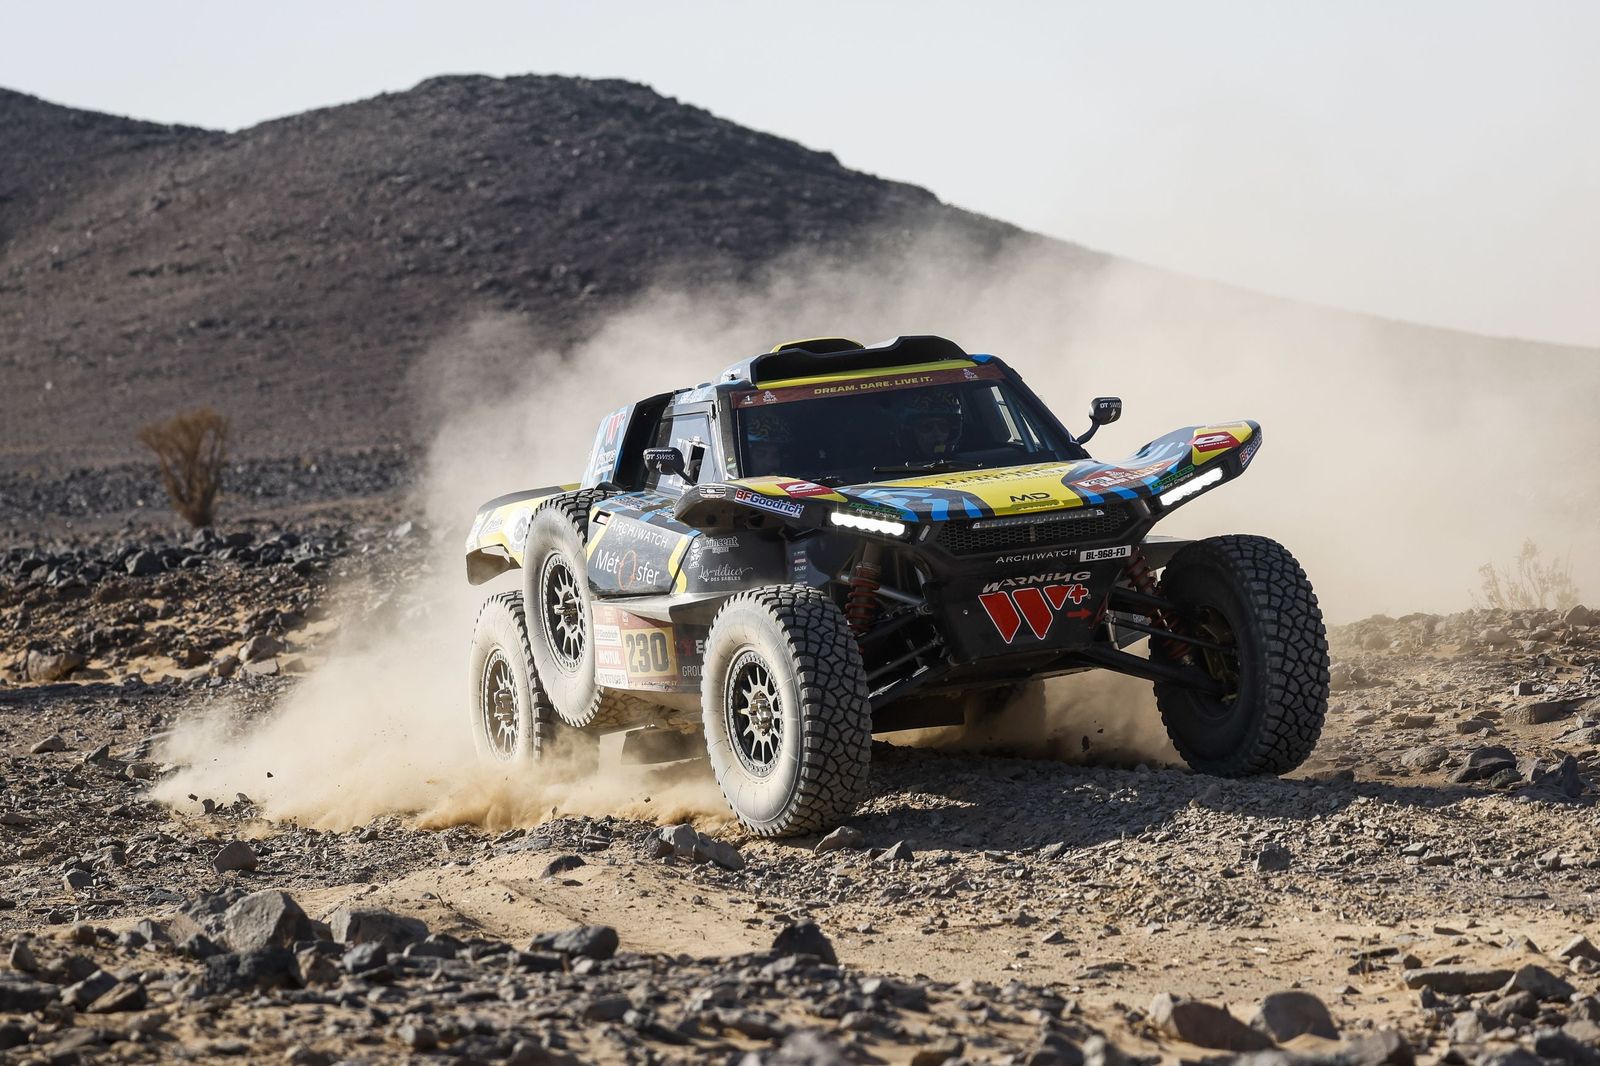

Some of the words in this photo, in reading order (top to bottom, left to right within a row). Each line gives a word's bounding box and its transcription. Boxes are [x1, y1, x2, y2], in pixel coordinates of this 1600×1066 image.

[813, 385, 858, 395] DREAM.
[860, 381, 893, 390] DARE.
[895, 378, 919, 386] LIVE
[736, 490, 803, 514] BFGoodrich
[1010, 492, 1050, 503] MD
[609, 518, 669, 548] ARCHIWATCH
[995, 548, 1078, 564] ARCHIWATCH
[1085, 547, 1127, 560] BL-968-FD
[625, 632, 670, 673] 230
